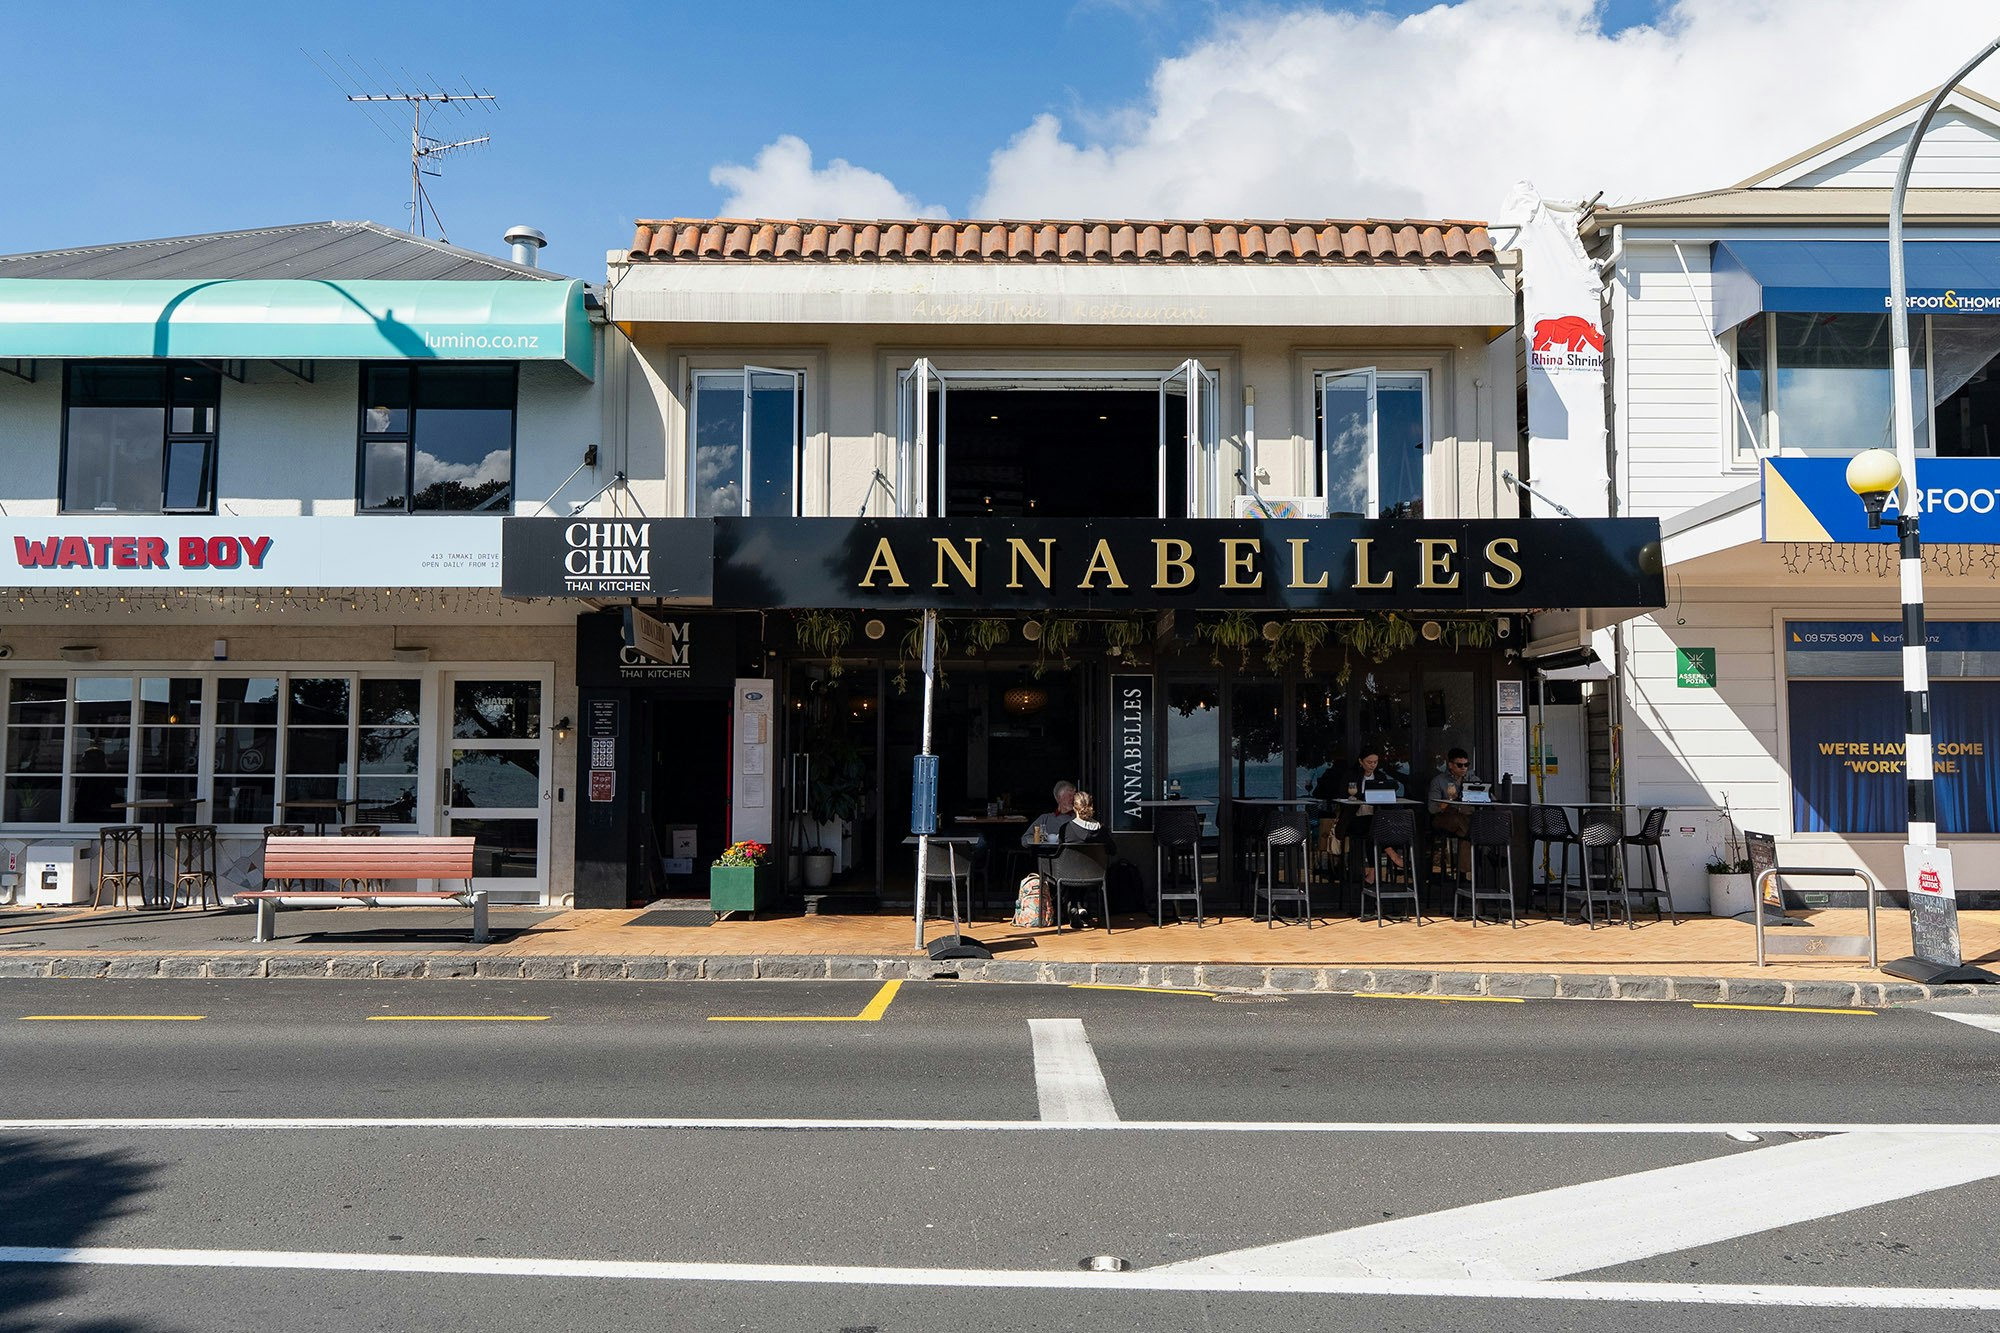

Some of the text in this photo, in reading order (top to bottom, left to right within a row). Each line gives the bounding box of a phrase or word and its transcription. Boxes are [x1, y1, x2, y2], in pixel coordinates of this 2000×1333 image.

[912, 299, 1211, 323] Angel Thai Restaurant
[425, 331, 539, 349] lumino.co.nz
[1531, 353, 1605, 367] Rhino Shrink
[565, 522, 651, 548] CHIM
[13, 536, 274, 569] WATER BOY
[564, 549, 651, 575] CHIM
[858, 537, 1523, 590] ANNABELLES
[565, 581, 650, 591] THAI KITCHEN
[1804, 633, 1864, 643] 09 575 9079
[620, 670, 690, 679] THAI KITCHEN
[481, 697, 514, 705] WATER
[1124, 688, 1142, 818] ANNABELLES
[1818, 742, 1870, 756] WE’RE
[1937, 742, 1984, 756] SOME
[1921, 873, 1938, 882] STELLA
[1921, 880, 1939, 889] ARTOIS
